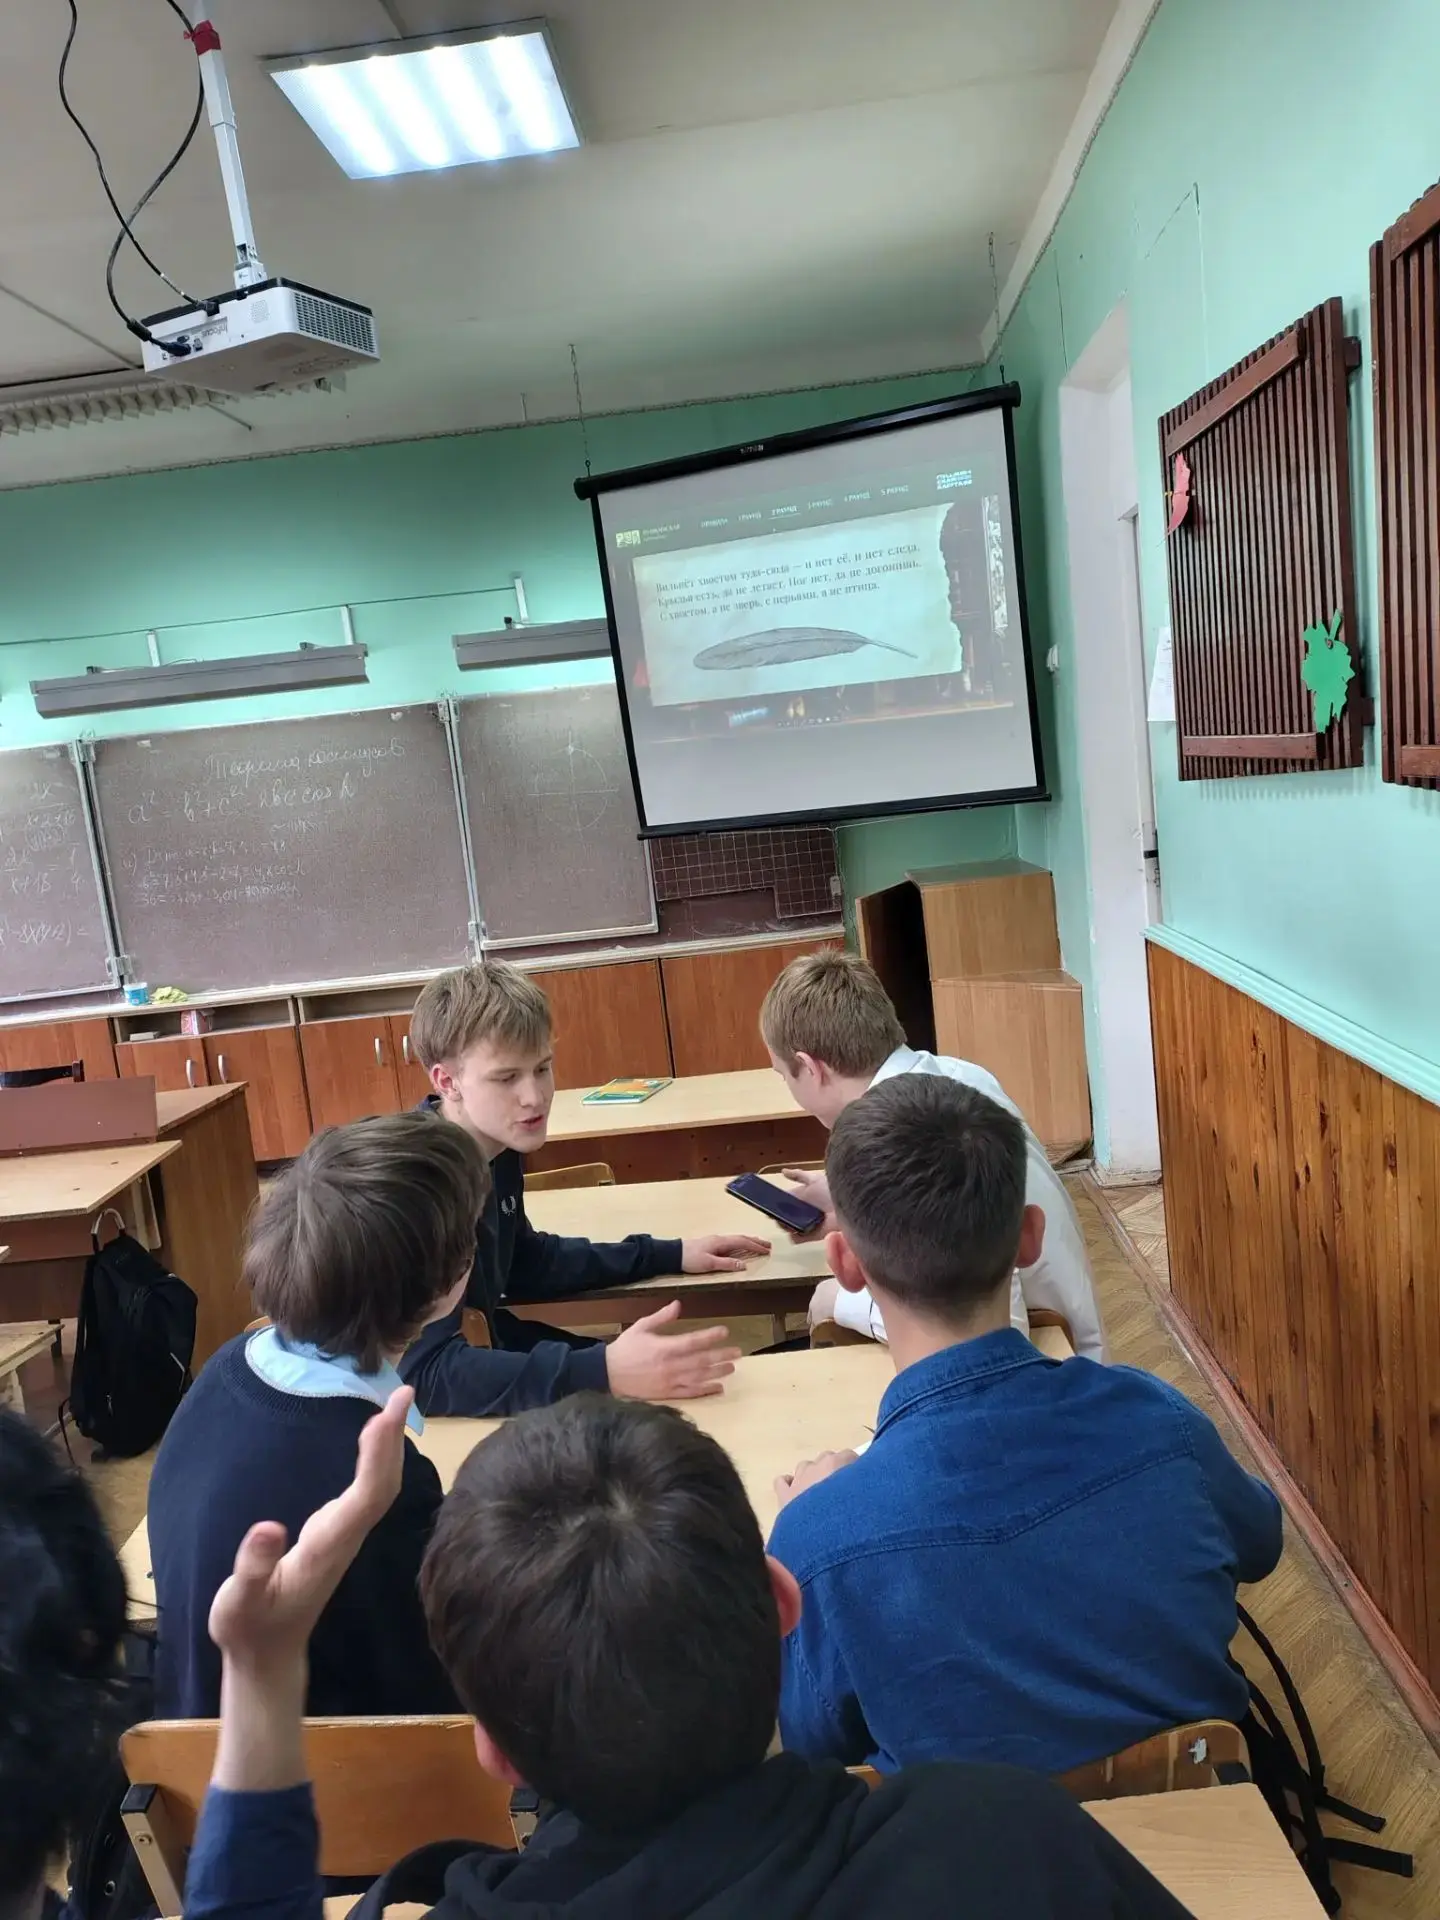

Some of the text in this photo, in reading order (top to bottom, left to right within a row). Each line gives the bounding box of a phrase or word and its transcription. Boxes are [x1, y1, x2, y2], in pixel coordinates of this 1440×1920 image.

[698, 573, 737, 587] хвостом
[740, 565, 790, 581] туда-сюда
[815, 558, 832, 568] нет
[865, 549, 884, 560] нет
[658, 593, 693, 608] Крылья
[736, 585, 747, 595] не
[789, 576, 807, 588] Ног
[834, 571, 846, 581] да
[850, 567, 862, 578] не
[720, 603, 731, 613] не
[830, 586, 842, 597] не
